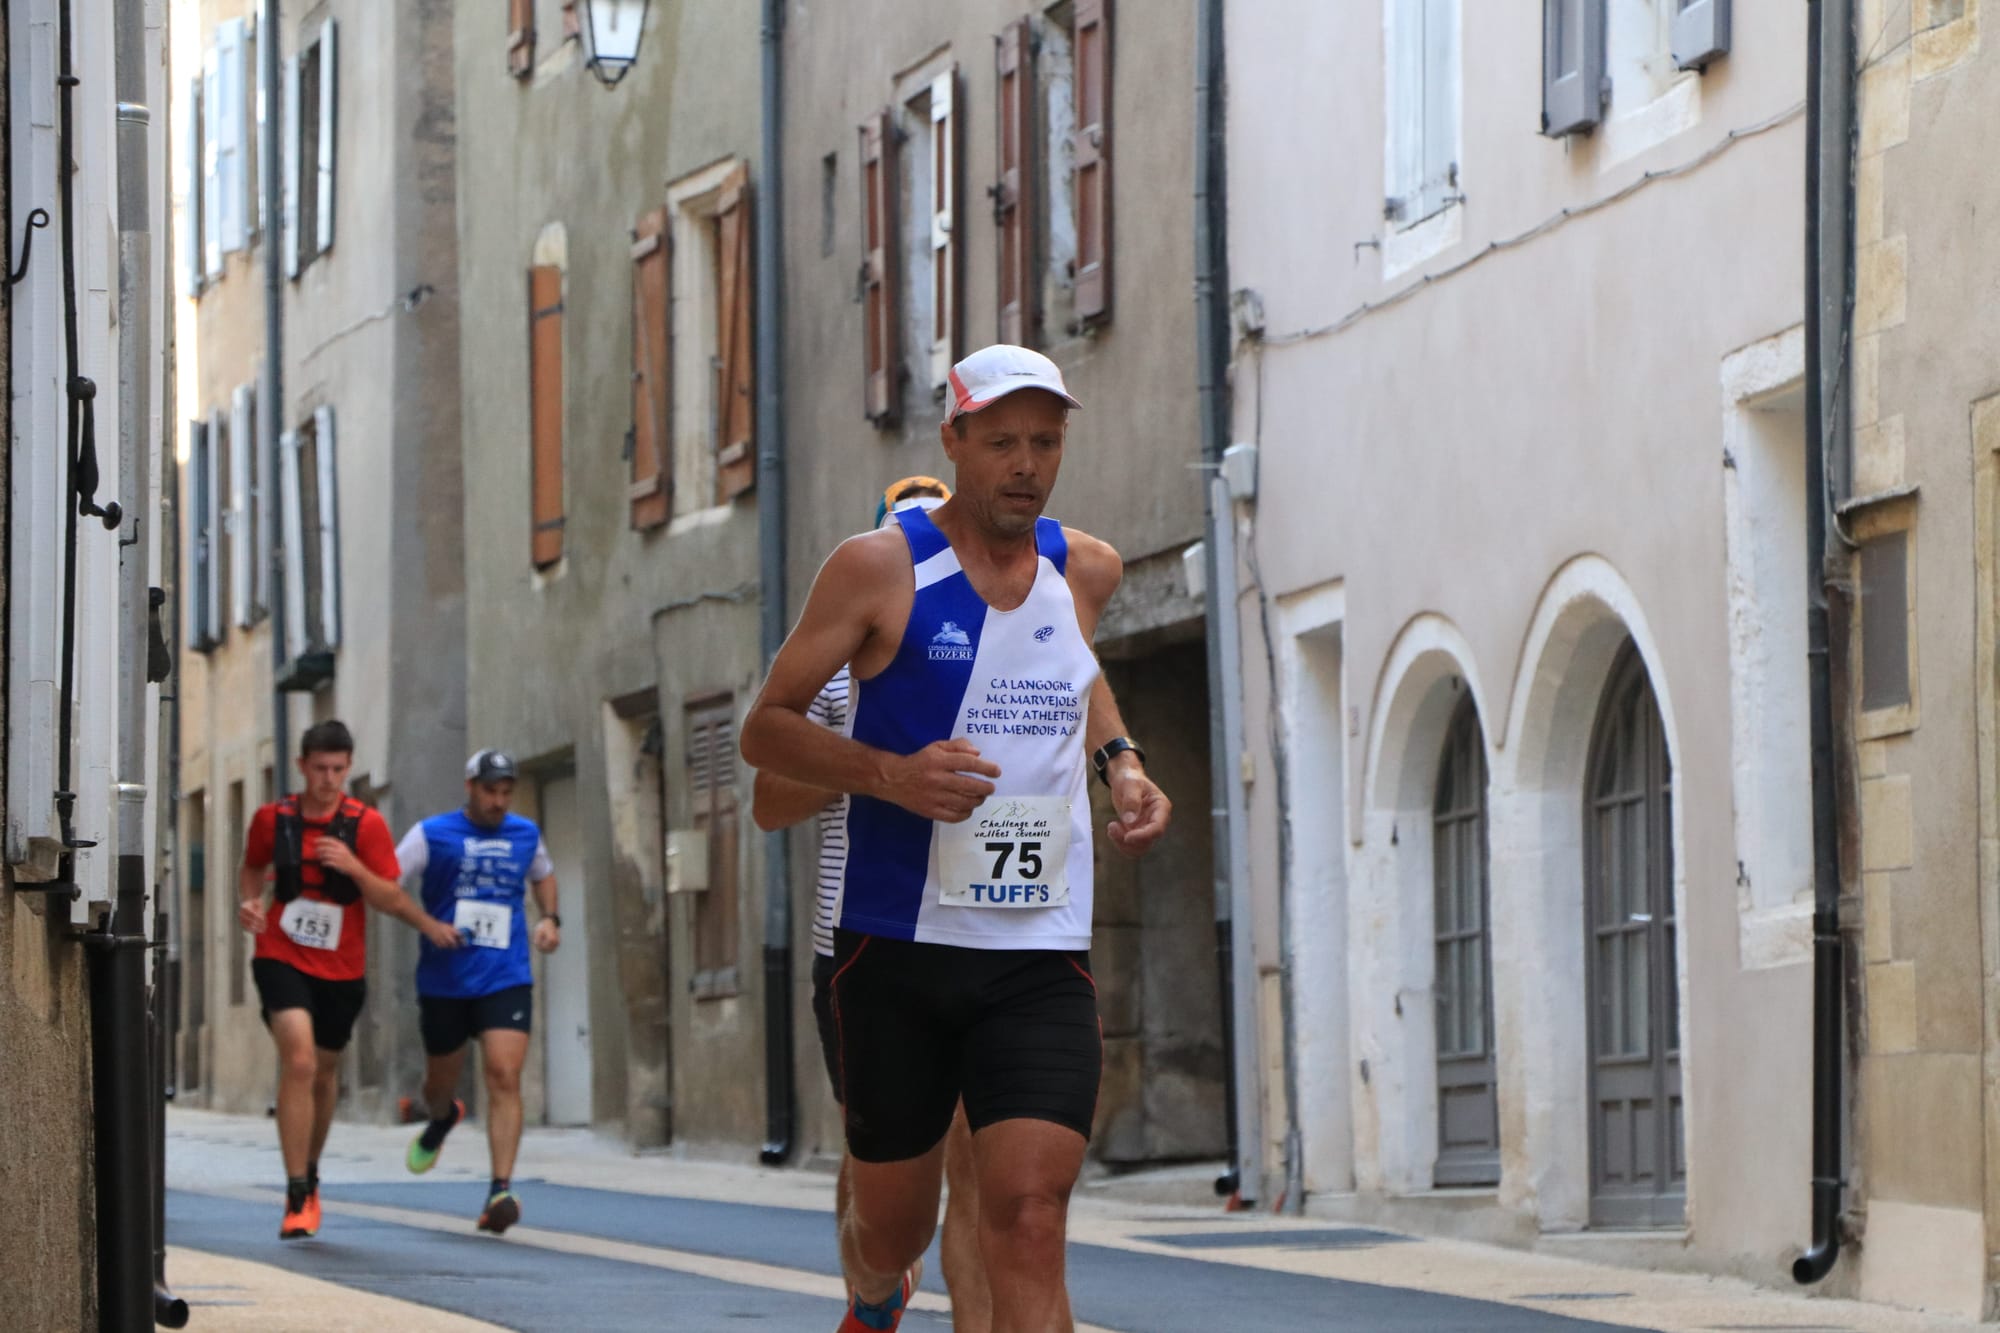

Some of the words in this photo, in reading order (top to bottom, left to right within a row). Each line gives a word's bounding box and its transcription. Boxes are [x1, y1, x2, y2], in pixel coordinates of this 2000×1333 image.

[927, 650, 974, 660] LOZERE
[990, 678, 1008, 689] C.A
[1010, 679, 1074, 692] LANGOGNE
[986, 694, 1008, 705] M.C
[1009, 695, 1078, 707] MARVEJOLS
[967, 708, 979, 719] St
[981, 709, 1019, 720] CHELY
[966, 723, 1000, 735] EVEIL
[1002, 724, 1057, 736] MENDOIS
[980, 819, 1029, 833] Challenge
[1033, 819, 1047, 828] des
[974, 829, 1009, 838] vallées
[1015, 828, 1051, 838] cévenoles
[985, 841, 1043, 880] 75
[969, 884, 1049, 903] TUFF'S
[294, 917, 331, 938] 153
